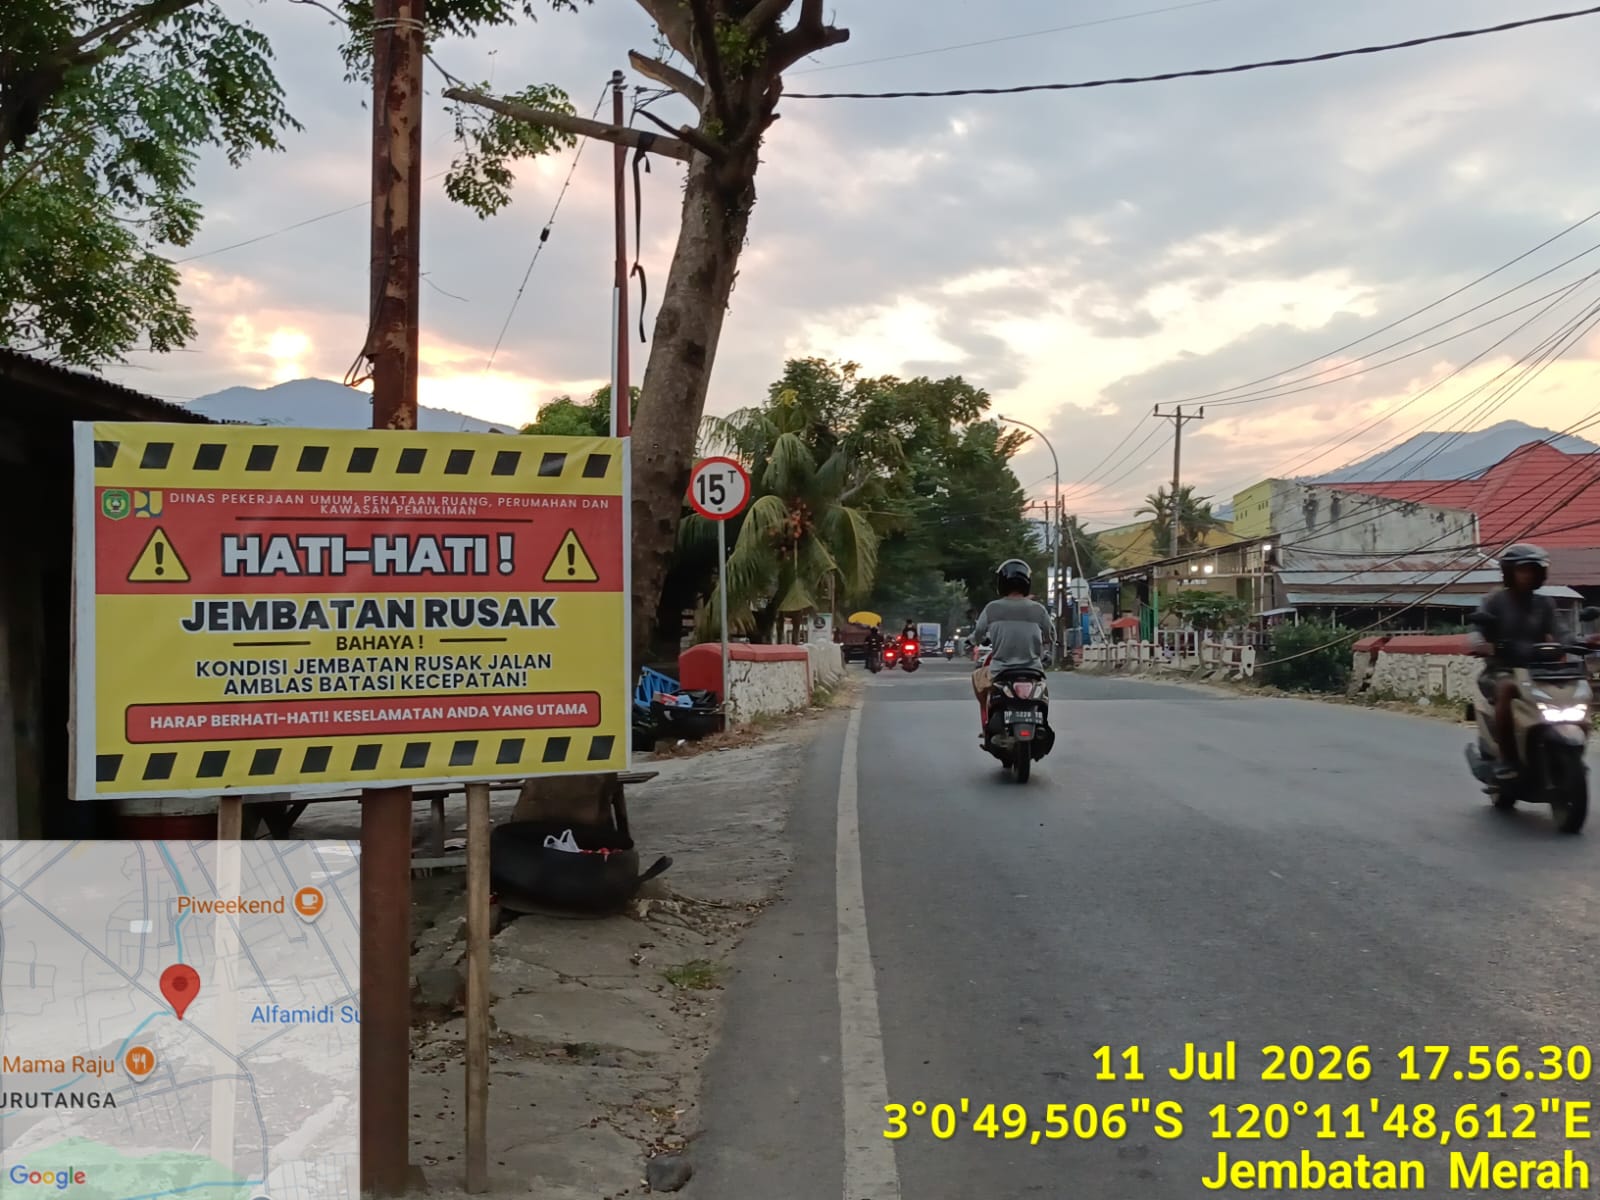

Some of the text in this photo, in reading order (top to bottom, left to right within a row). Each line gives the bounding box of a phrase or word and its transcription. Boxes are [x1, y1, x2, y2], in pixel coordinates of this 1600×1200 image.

[169, 492, 609, 509] DINAS PEKERJAAN UMUM, PENATAAN RUANG, PERUMAHAN DAN
[320, 504, 477, 516] KAWASAN PEMUKIMAN
[221, 533, 489, 576] HATI-HATI
[181, 597, 557, 633] JEMBATAN RUSAK
[336, 635, 414, 651] BAHAYA
[196, 653, 552, 677] KONDISI JEMBATAN RUSAK JALAN
[223, 671, 527, 695] AMBLAS BATASI KECEPATAN!
[150, 703, 588, 729] HARAP BERHATI-HATI! KESELAMATAN ANDA YANG UTAMA
